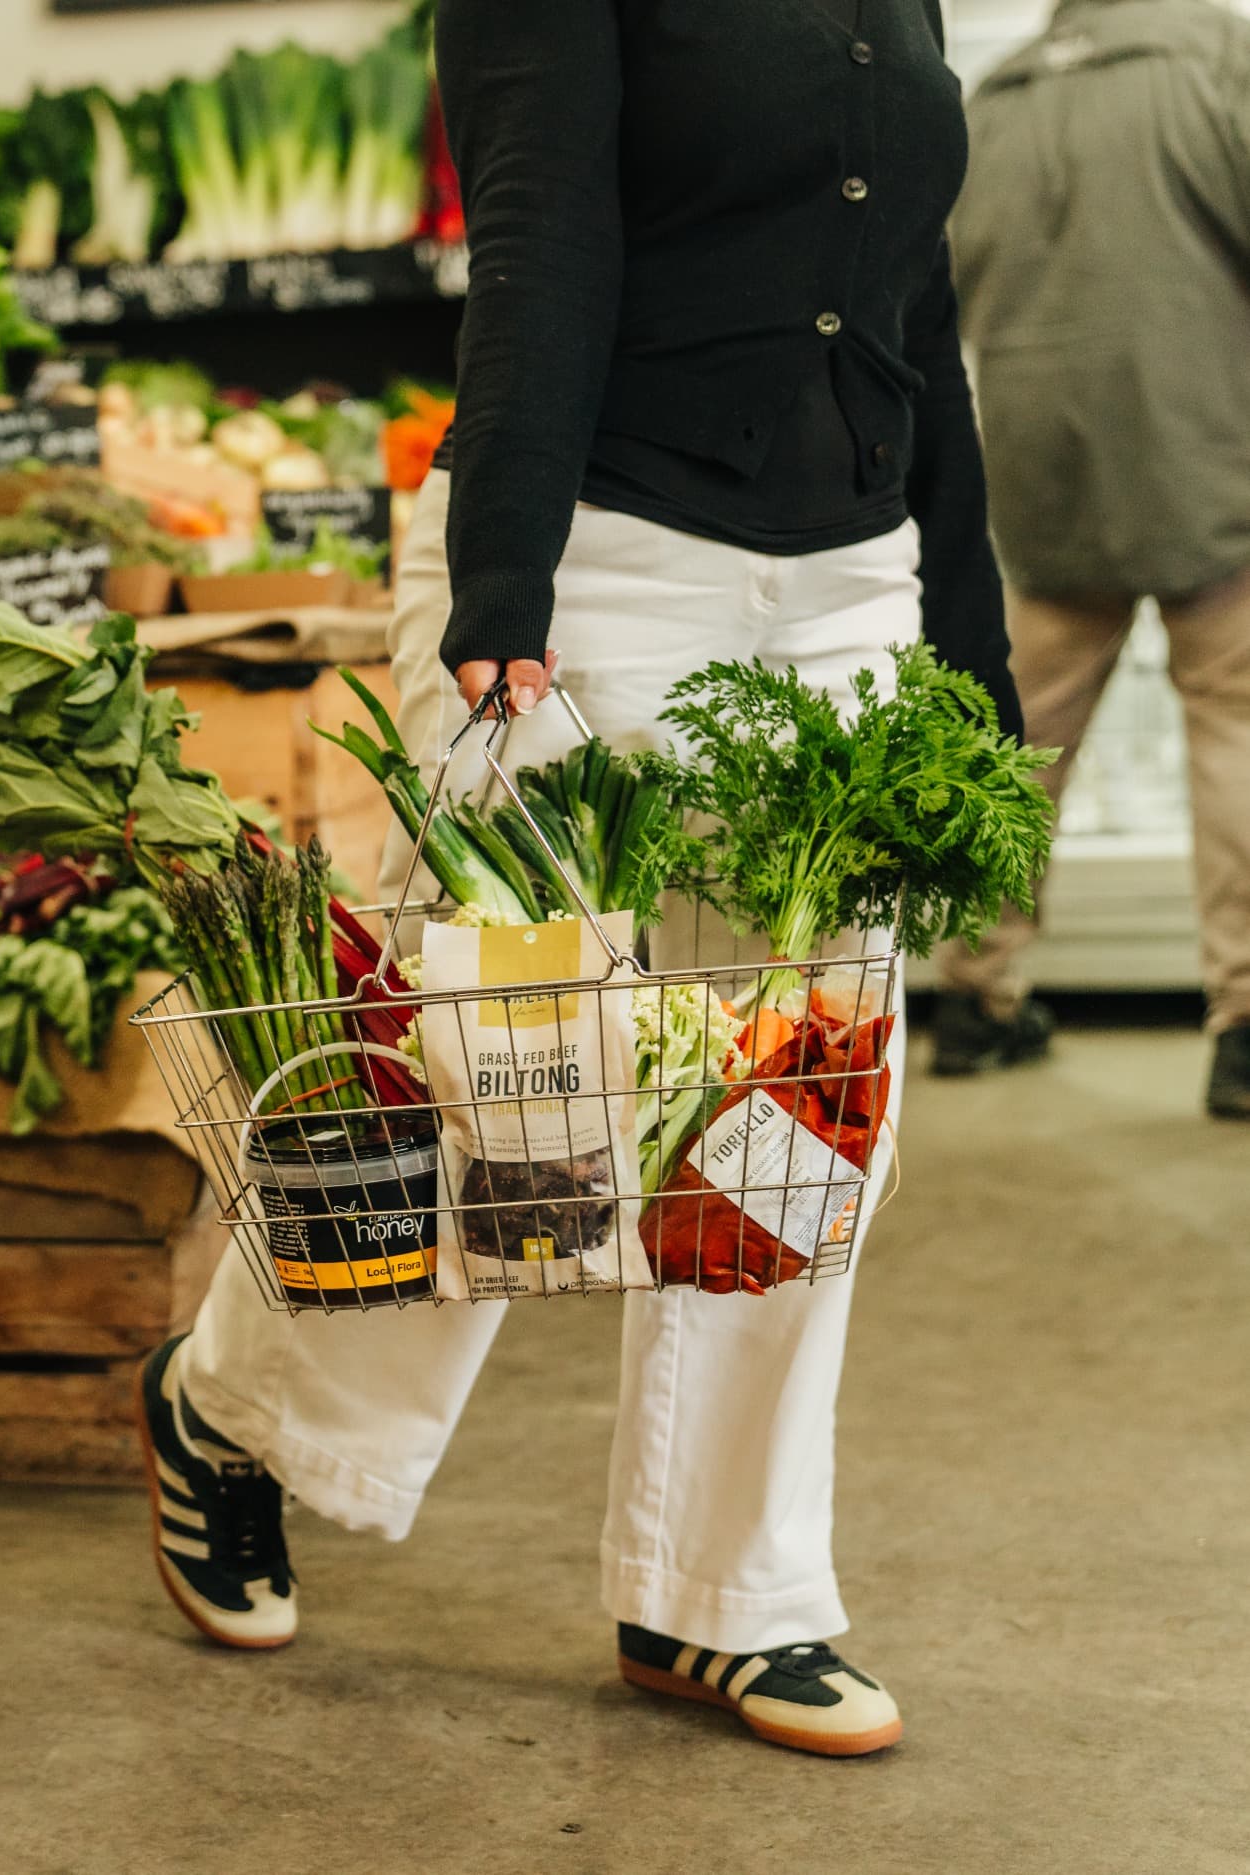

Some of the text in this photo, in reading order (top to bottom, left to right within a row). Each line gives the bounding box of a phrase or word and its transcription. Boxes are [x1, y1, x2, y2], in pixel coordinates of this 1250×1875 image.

[478, 1052, 518, 1066] GRASS
[524, 1051, 545, 1064] FED
[477, 1063, 580, 1097] BILTONG
[492, 1099, 567, 1117] TRADTIONAL
[711, 1103, 775, 1164] TORELLO
[355, 1215, 425, 1243] honey
[366, 1261, 421, 1277] Local Flora
[504, 1275, 519, 1283] EEF
